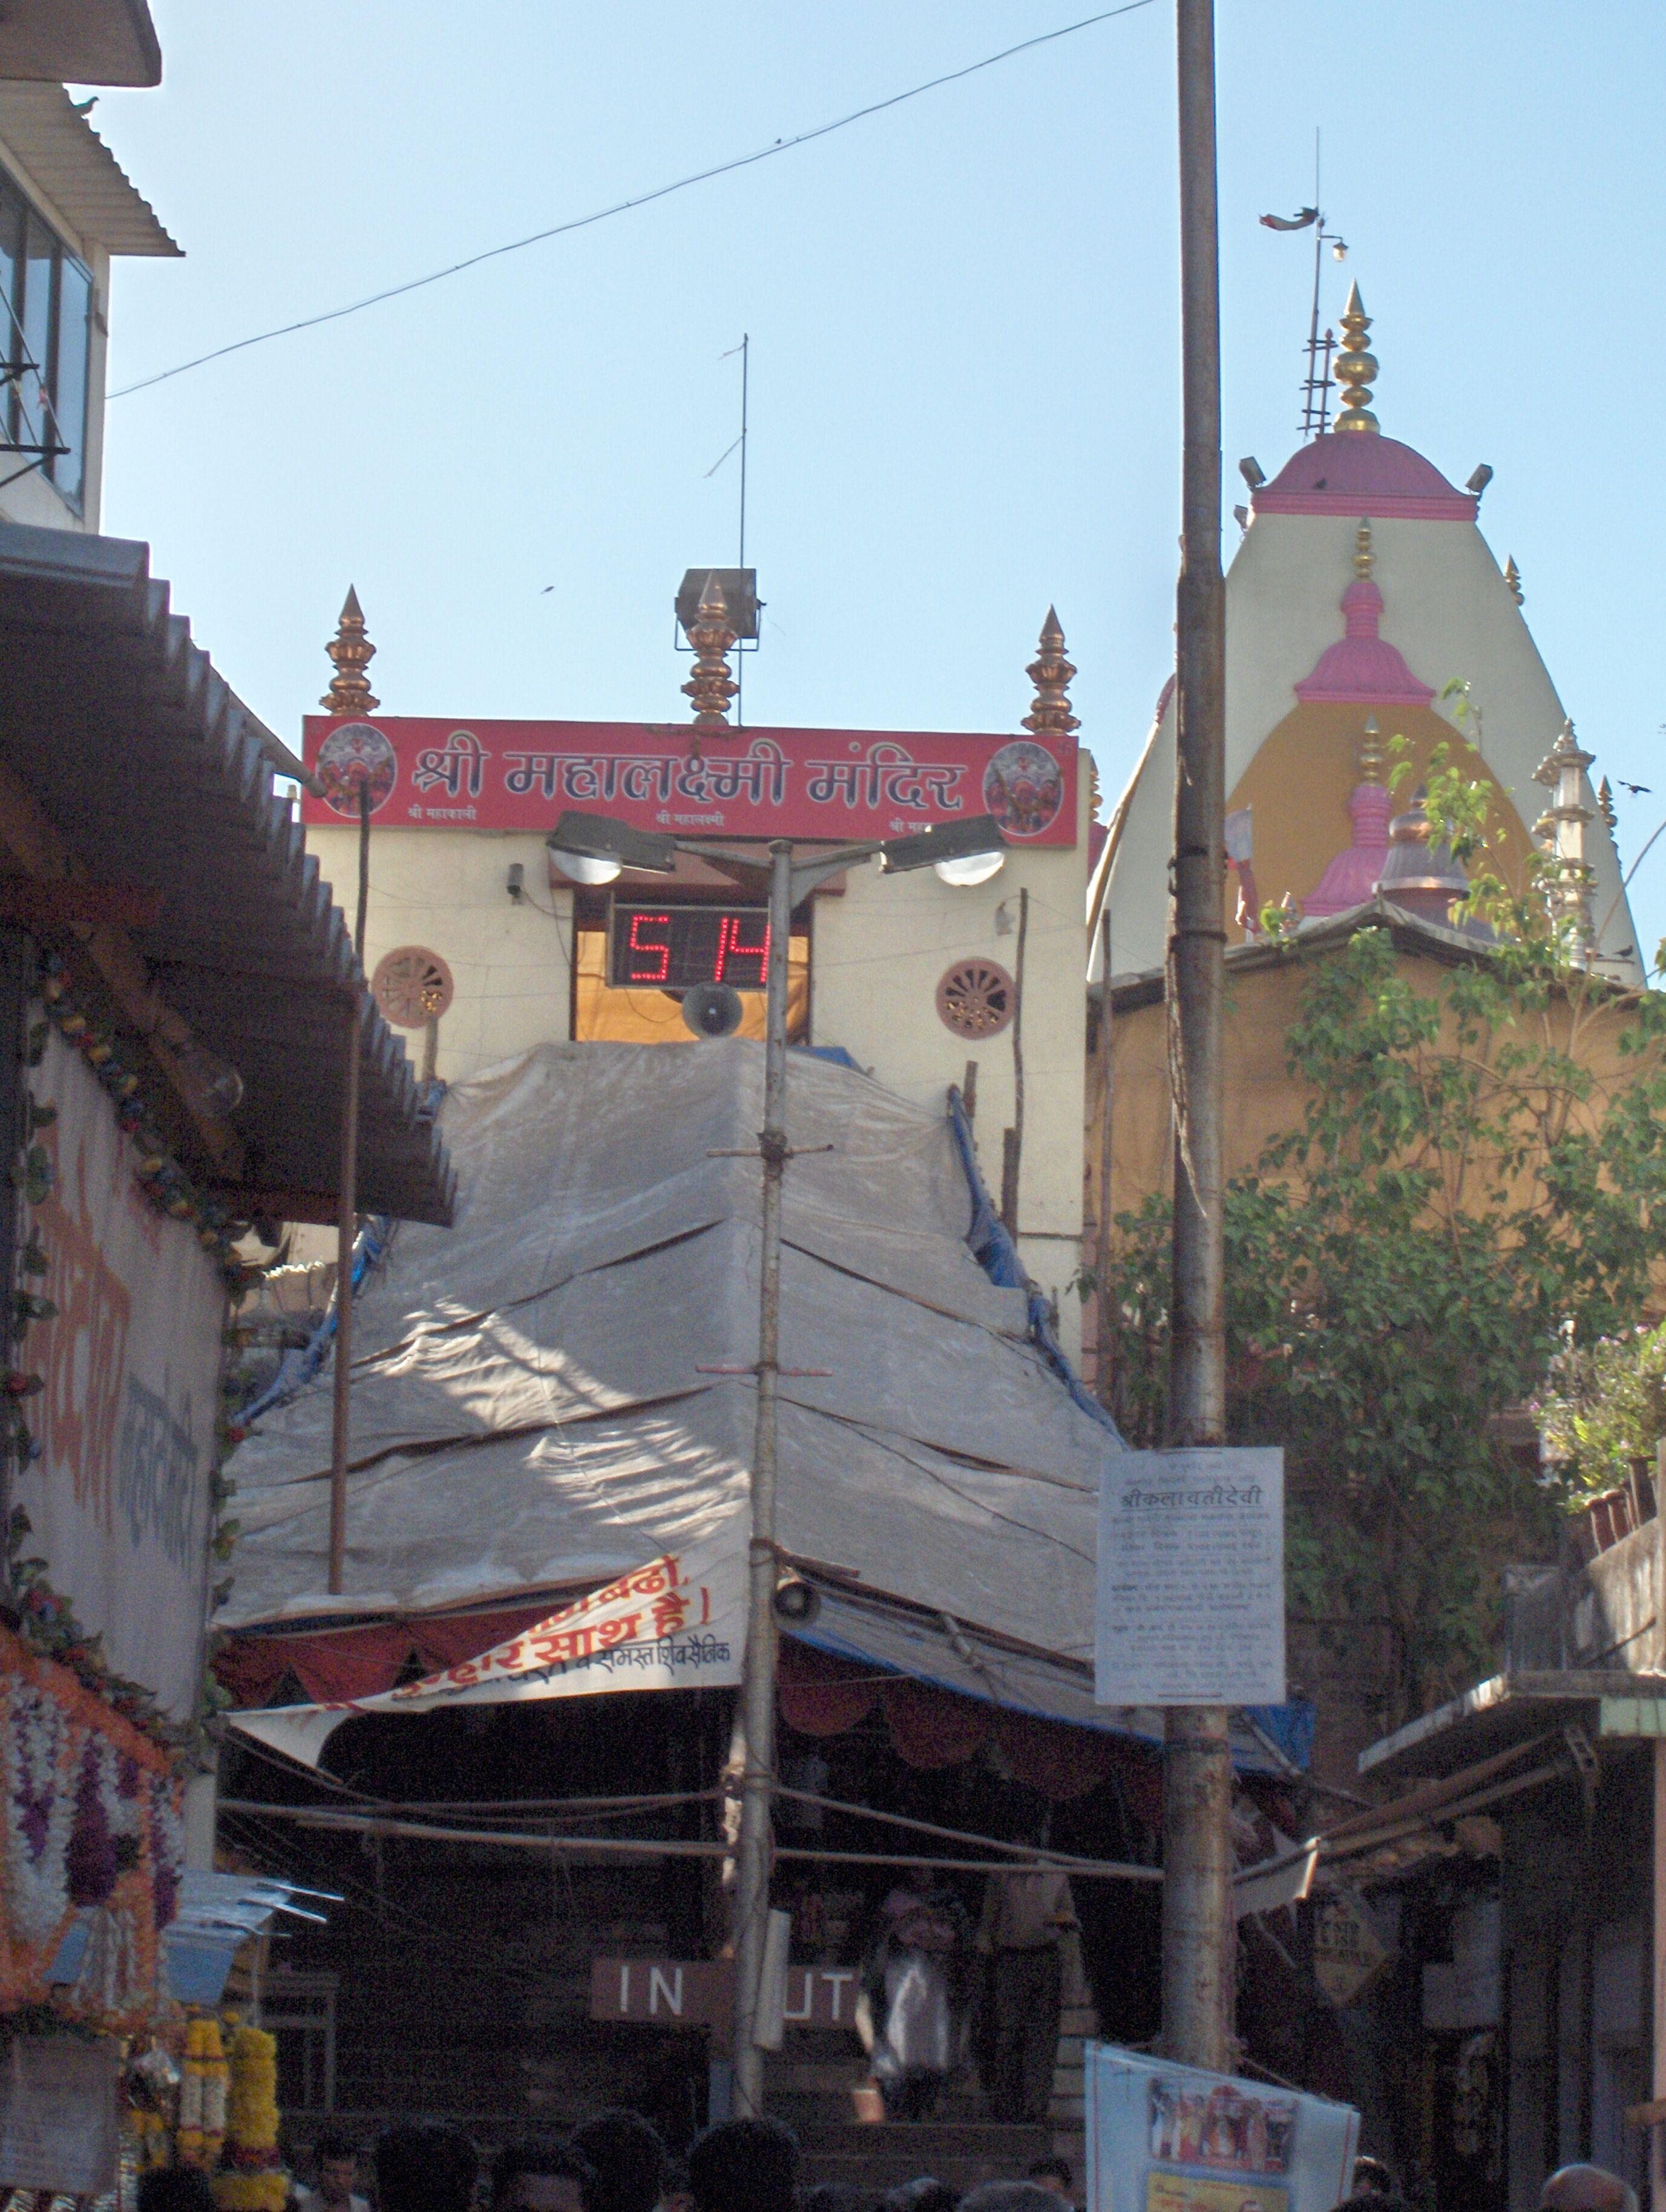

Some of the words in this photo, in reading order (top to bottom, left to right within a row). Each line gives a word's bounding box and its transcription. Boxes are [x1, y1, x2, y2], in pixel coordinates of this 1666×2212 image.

[413, 730, 491, 798] श्री
[502, 738, 793, 807] महालक्ष्मी
[805, 742, 968, 810] मंदिर
[408, 803, 422, 819] श्री
[656, 810, 670, 825] श्री
[889, 817, 904, 833] श्री
[529, 1612, 642, 1664] साथ
[620, 1965, 683, 2016] IN
[784, 1972, 853, 2021] UT
